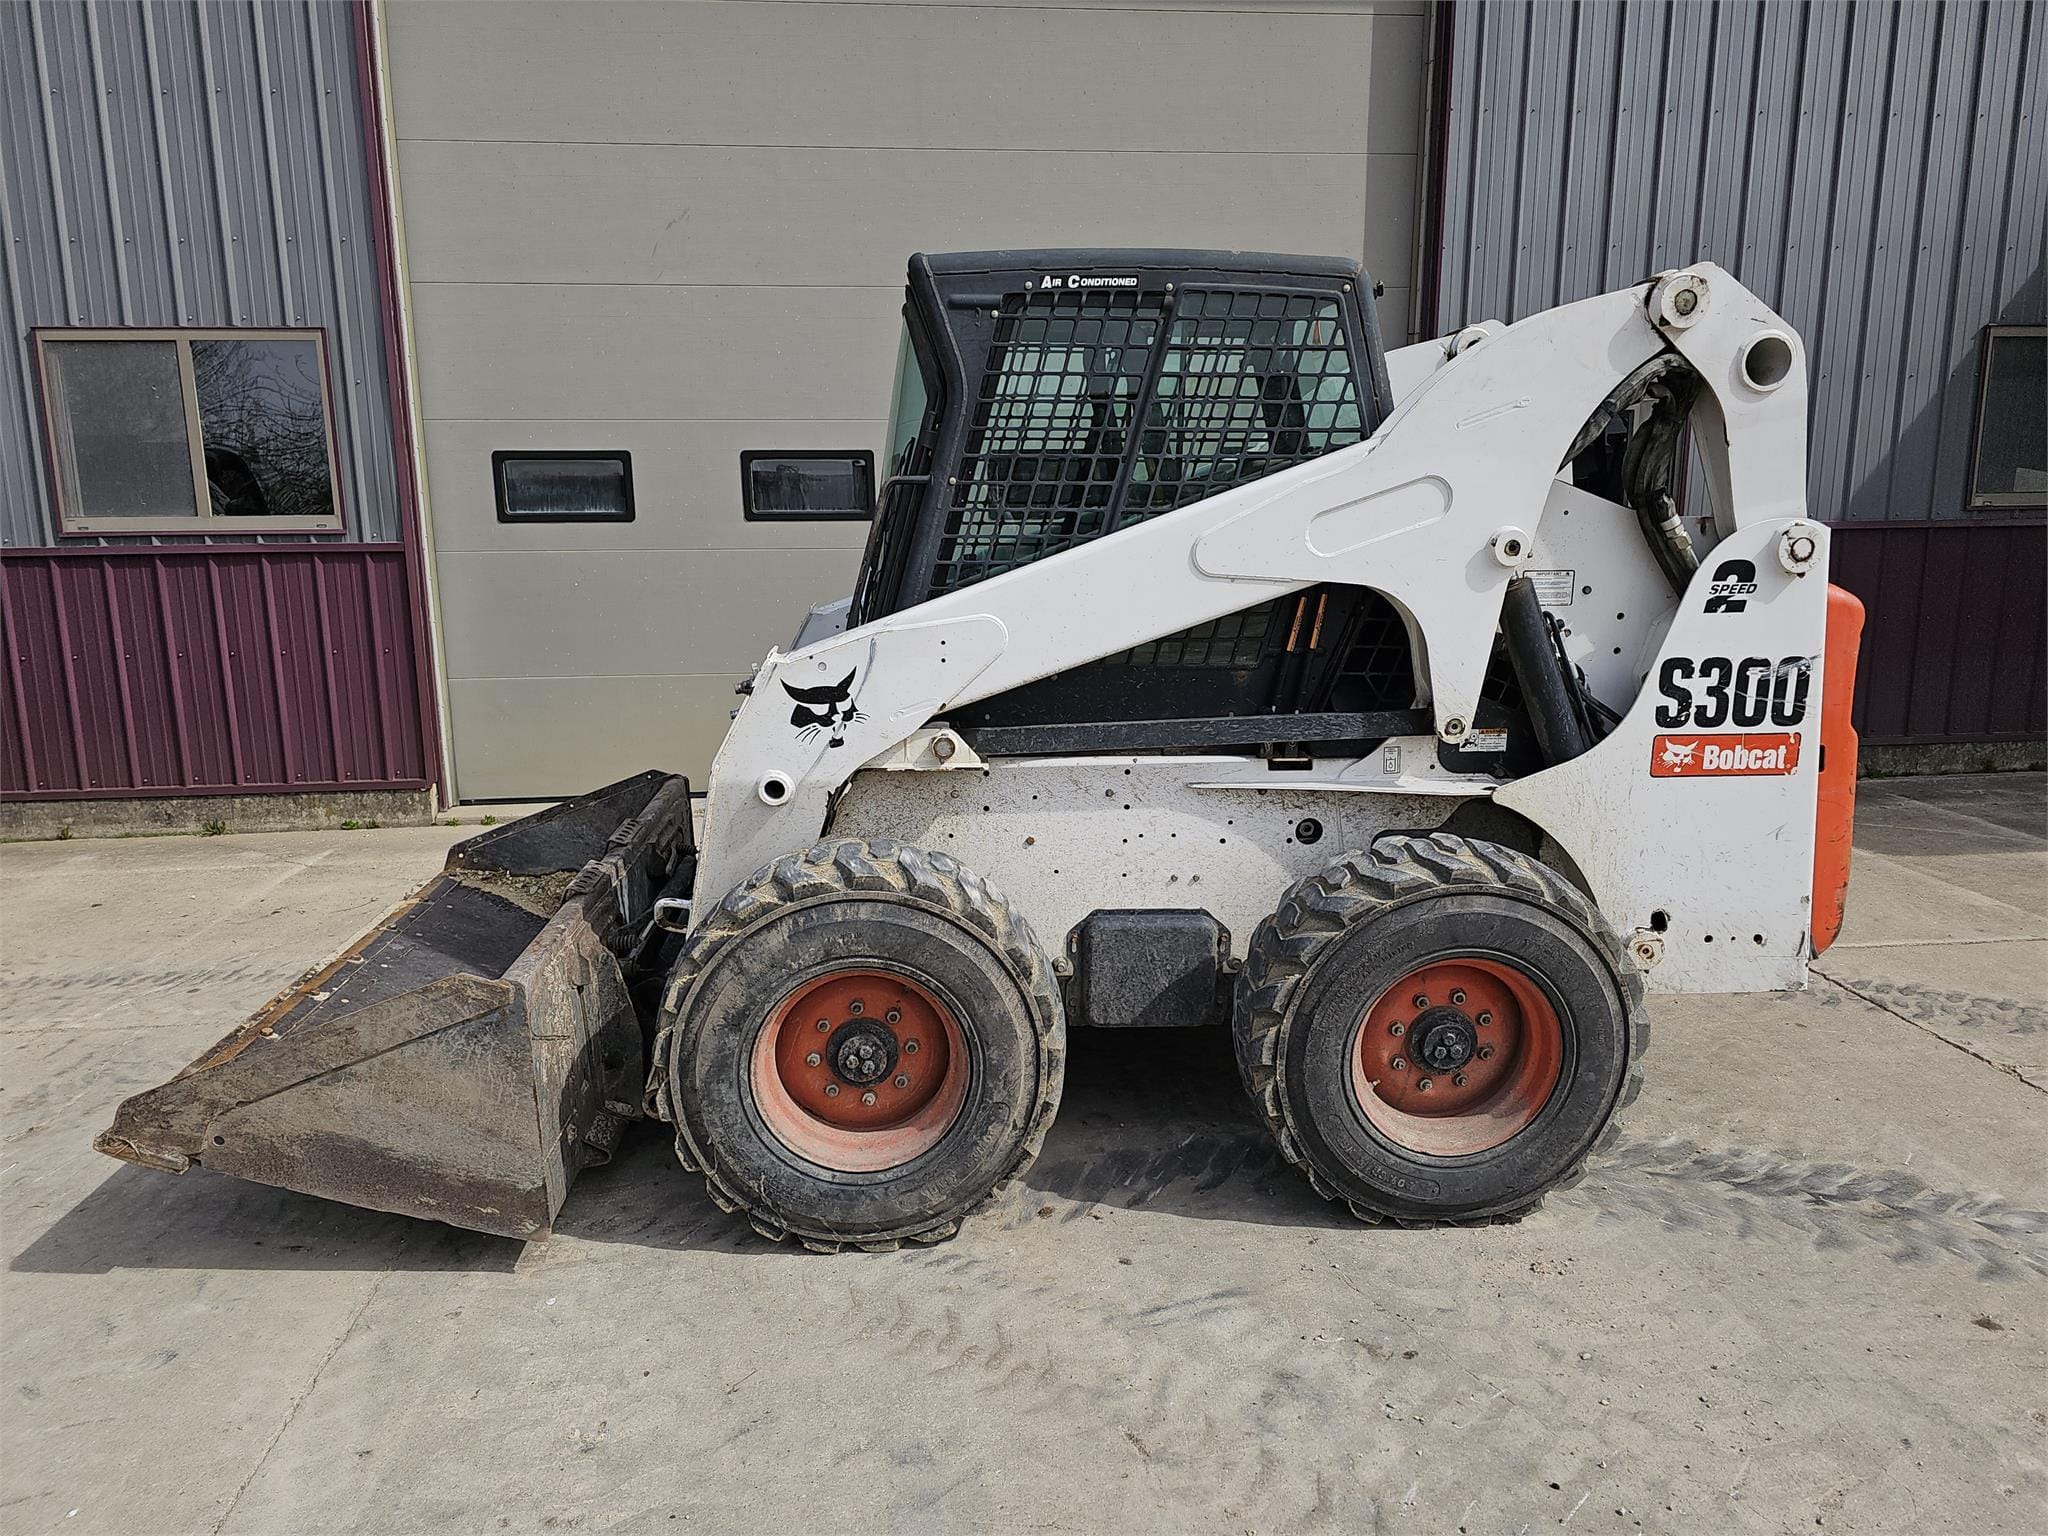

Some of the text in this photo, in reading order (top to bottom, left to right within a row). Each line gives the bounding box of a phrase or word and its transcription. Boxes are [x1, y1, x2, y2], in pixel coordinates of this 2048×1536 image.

[1041, 274, 1138, 289] AIR CONDITIONED
[1703, 559, 1756, 614] 2
[1709, 583, 1758, 595] SPEED
[1655, 655, 1812, 729] S300
[1702, 744, 1785, 771] Bobcat
